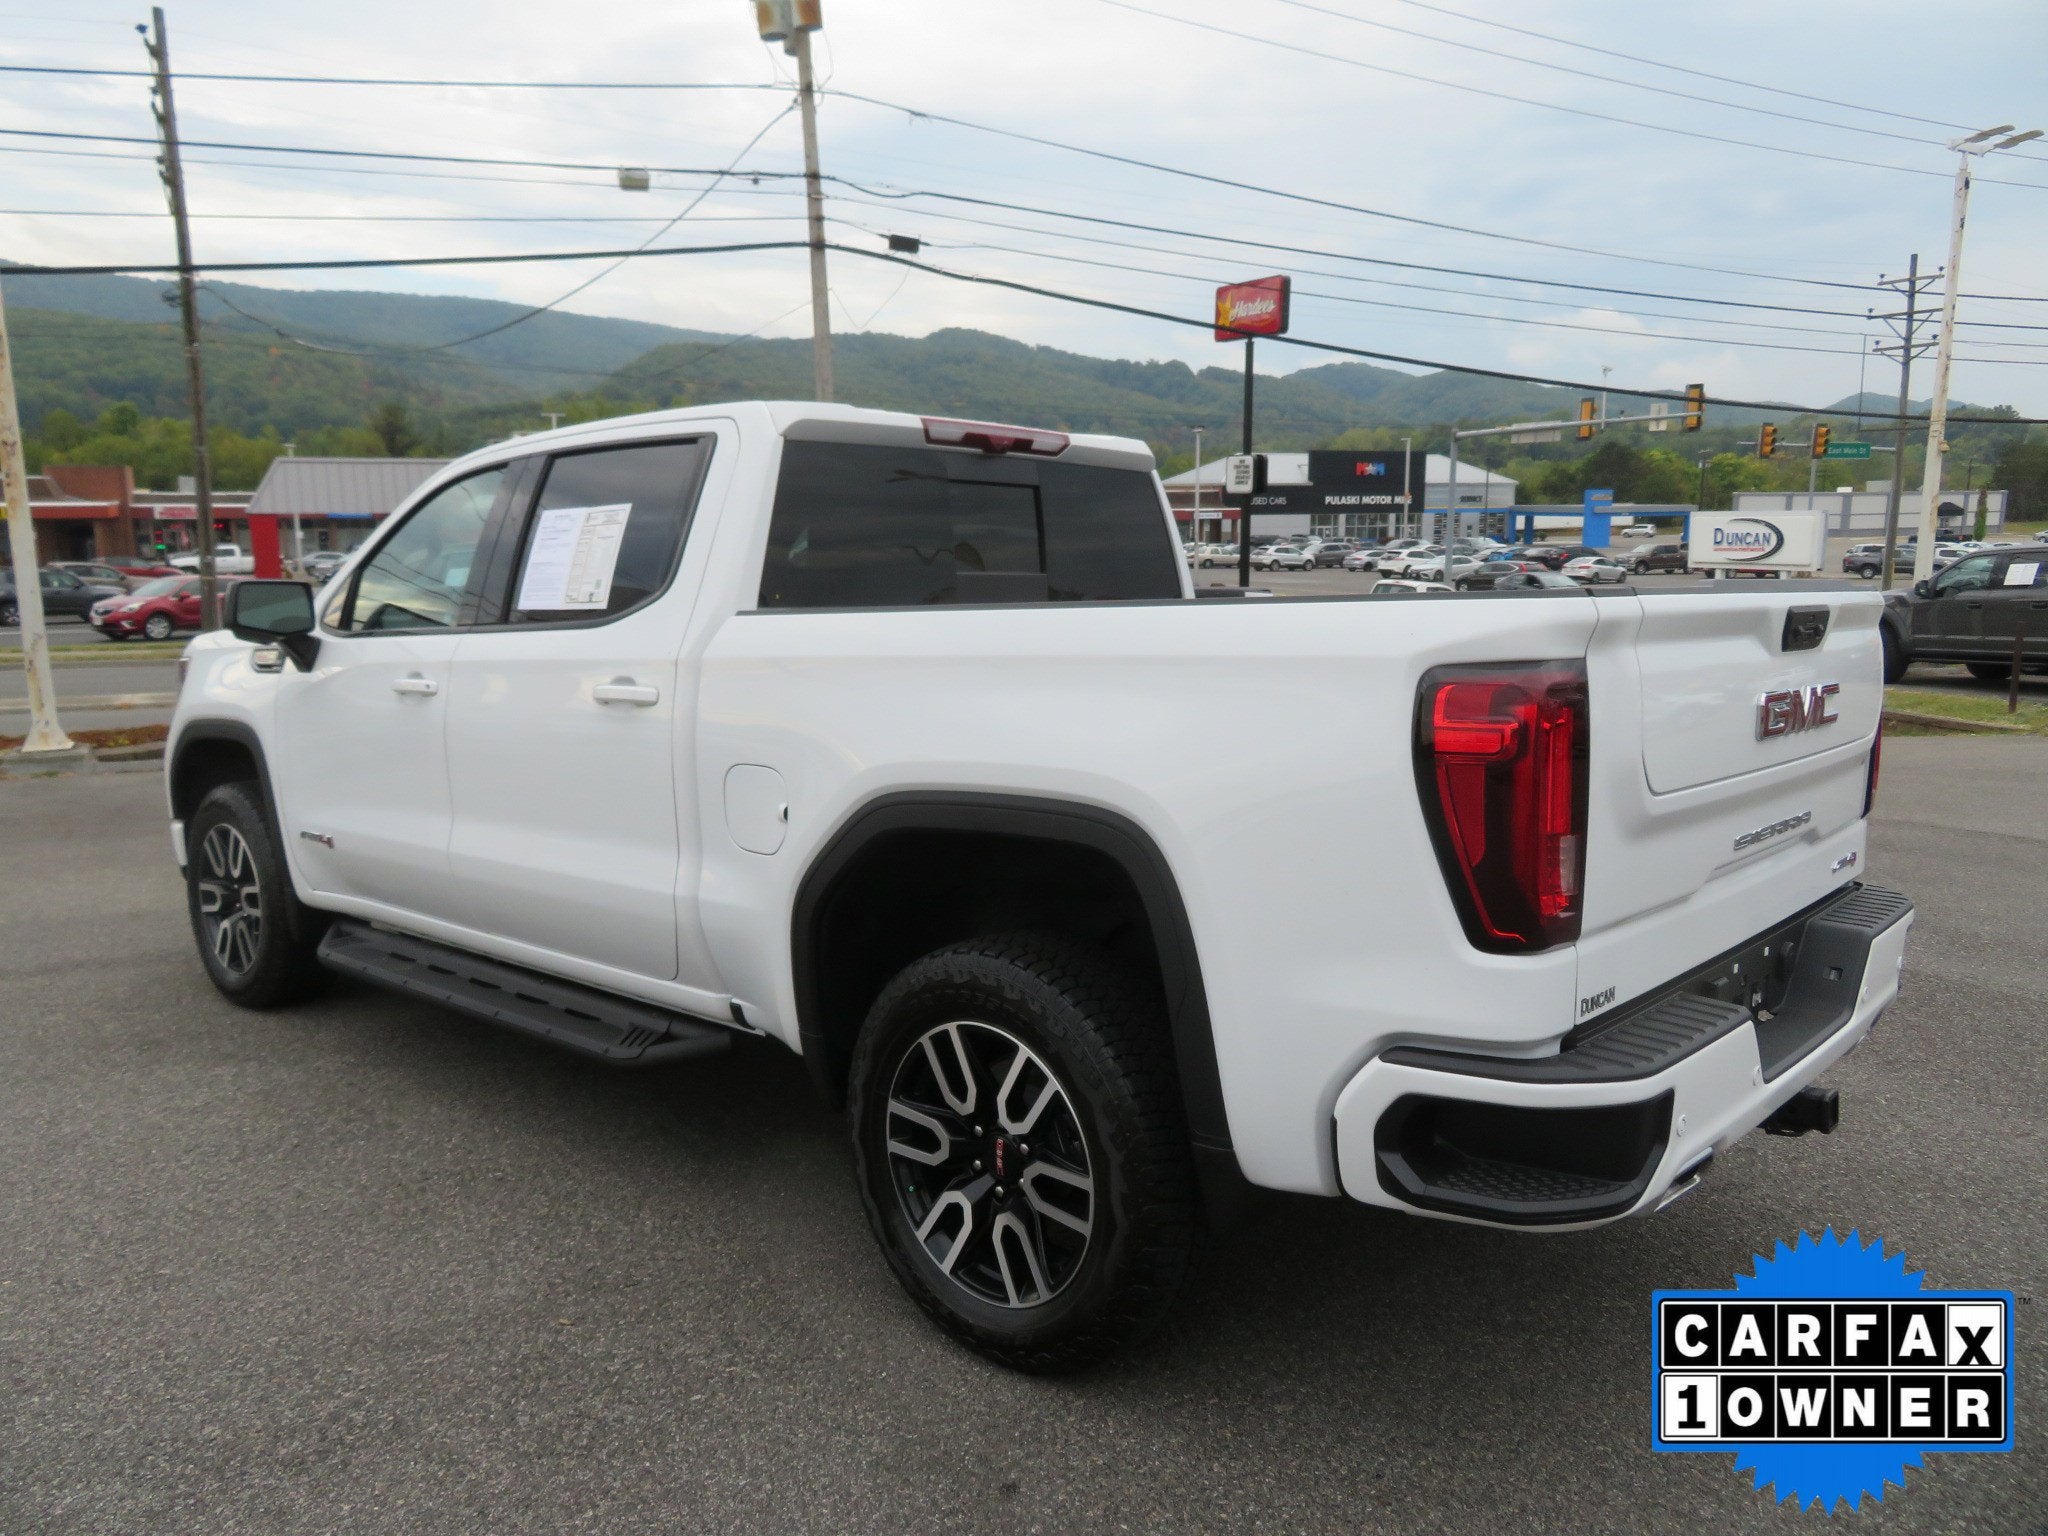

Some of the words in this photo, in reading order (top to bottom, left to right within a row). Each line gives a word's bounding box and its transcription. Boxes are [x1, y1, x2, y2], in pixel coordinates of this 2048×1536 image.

[1269, 496, 1288, 506] CARS
[1325, 495, 1360, 506] PULASKI
[1361, 495, 1392, 505] MOTOR
[1713, 528, 1772, 546] DUNCAN
[1756, 683, 1840, 741] GMC
[1734, 811, 1811, 851] SIERRA
[1580, 985, 1616, 1017] DUNCAN
